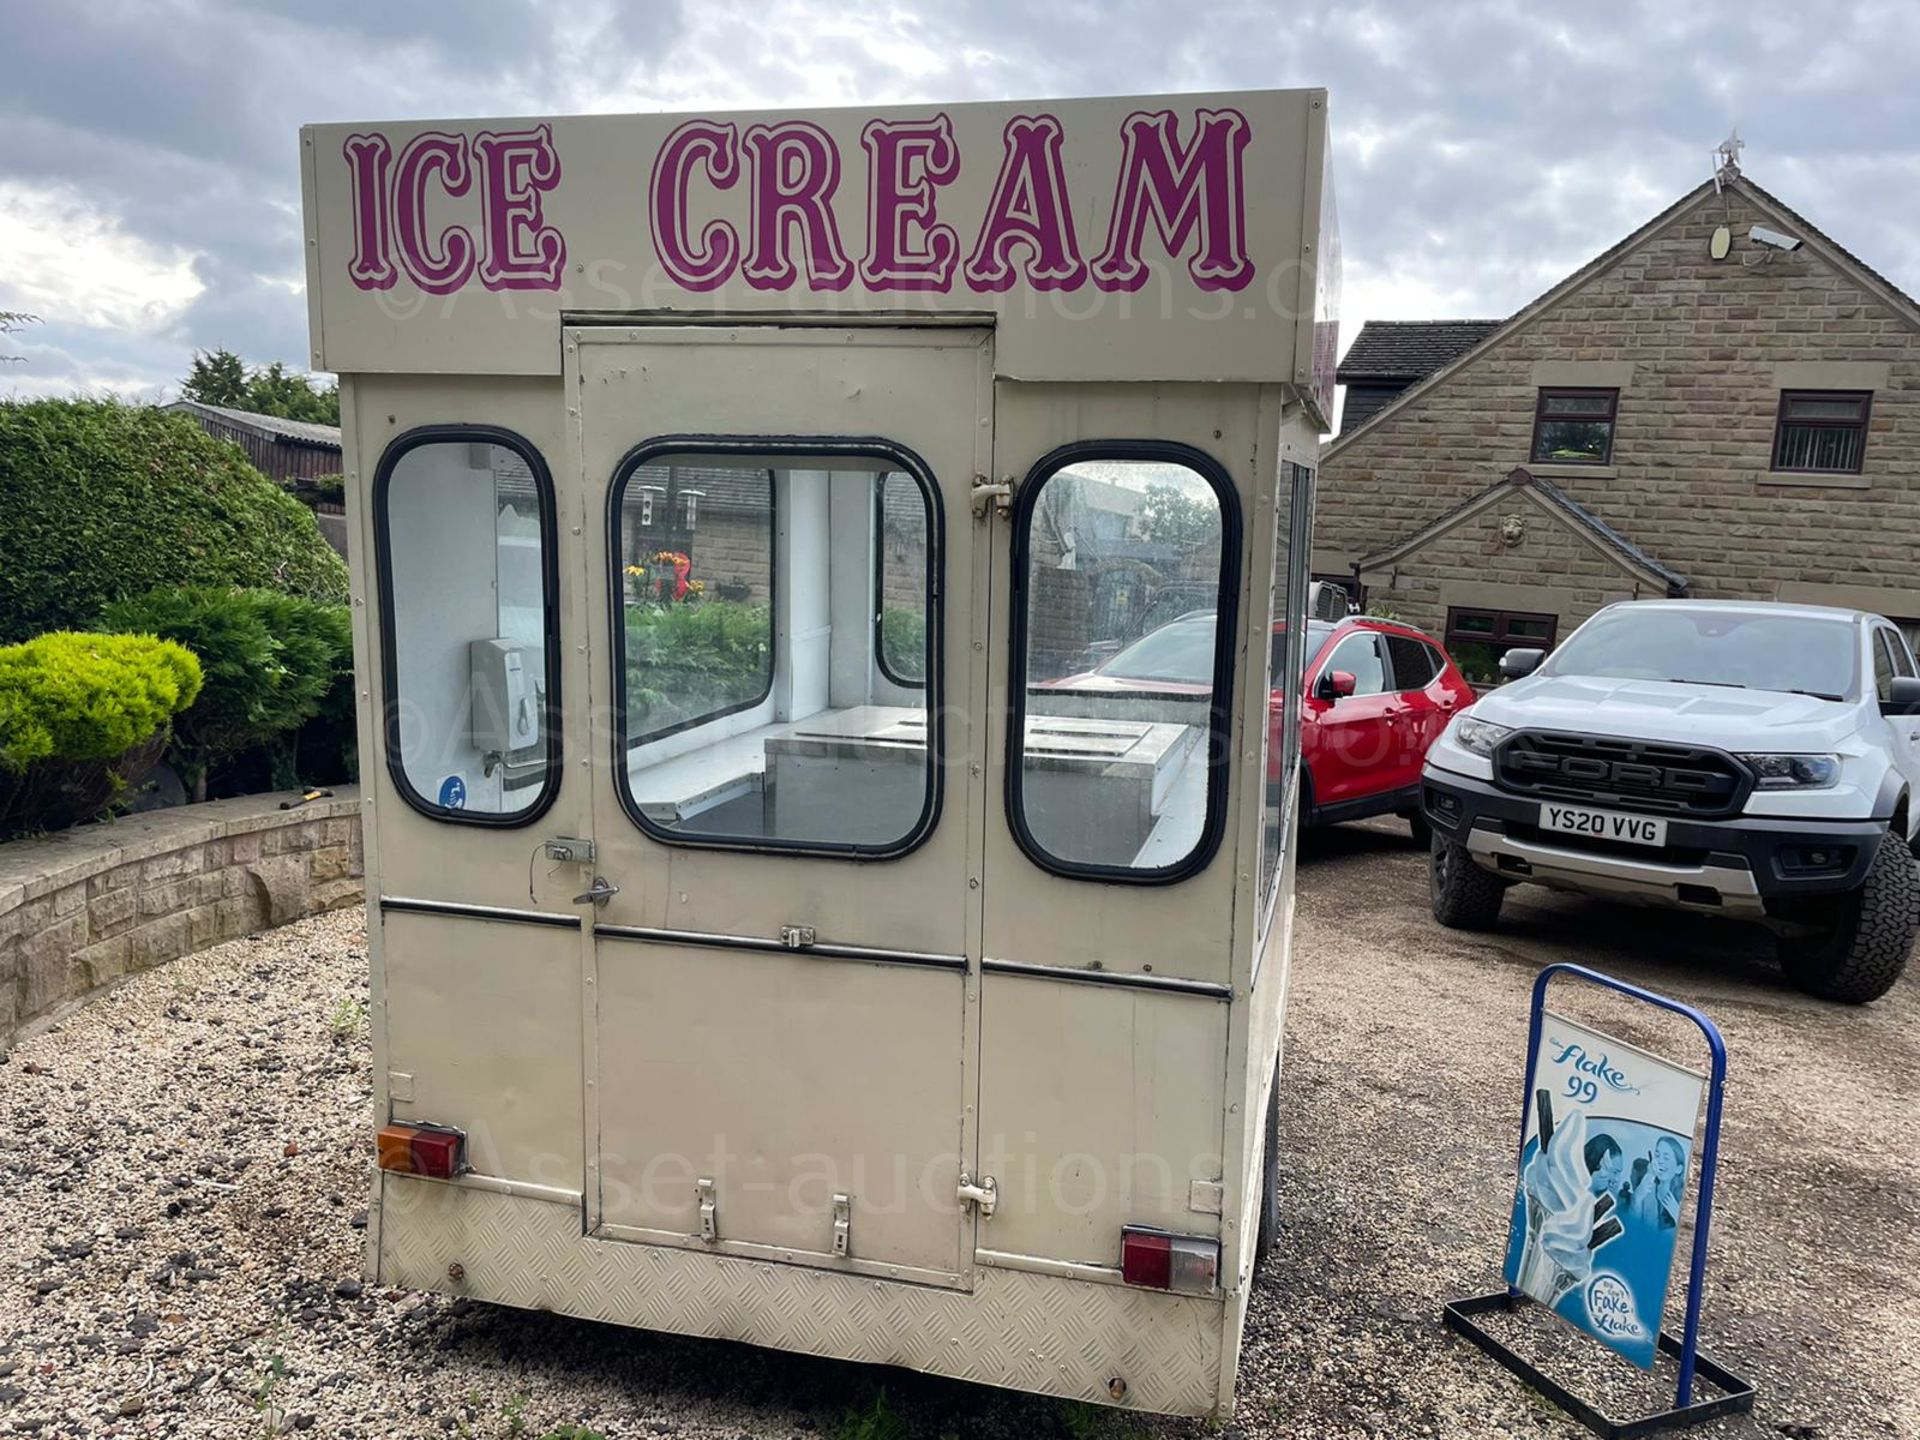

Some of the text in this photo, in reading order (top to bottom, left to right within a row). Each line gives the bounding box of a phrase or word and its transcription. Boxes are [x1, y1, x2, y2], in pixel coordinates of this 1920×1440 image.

[343, 107, 1256, 295] ICE CREAM
[1508, 750, 1735, 793] FORD
[1550, 807, 1657, 841] YS20 VVG
[1561, 1075, 1598, 1104] 99
